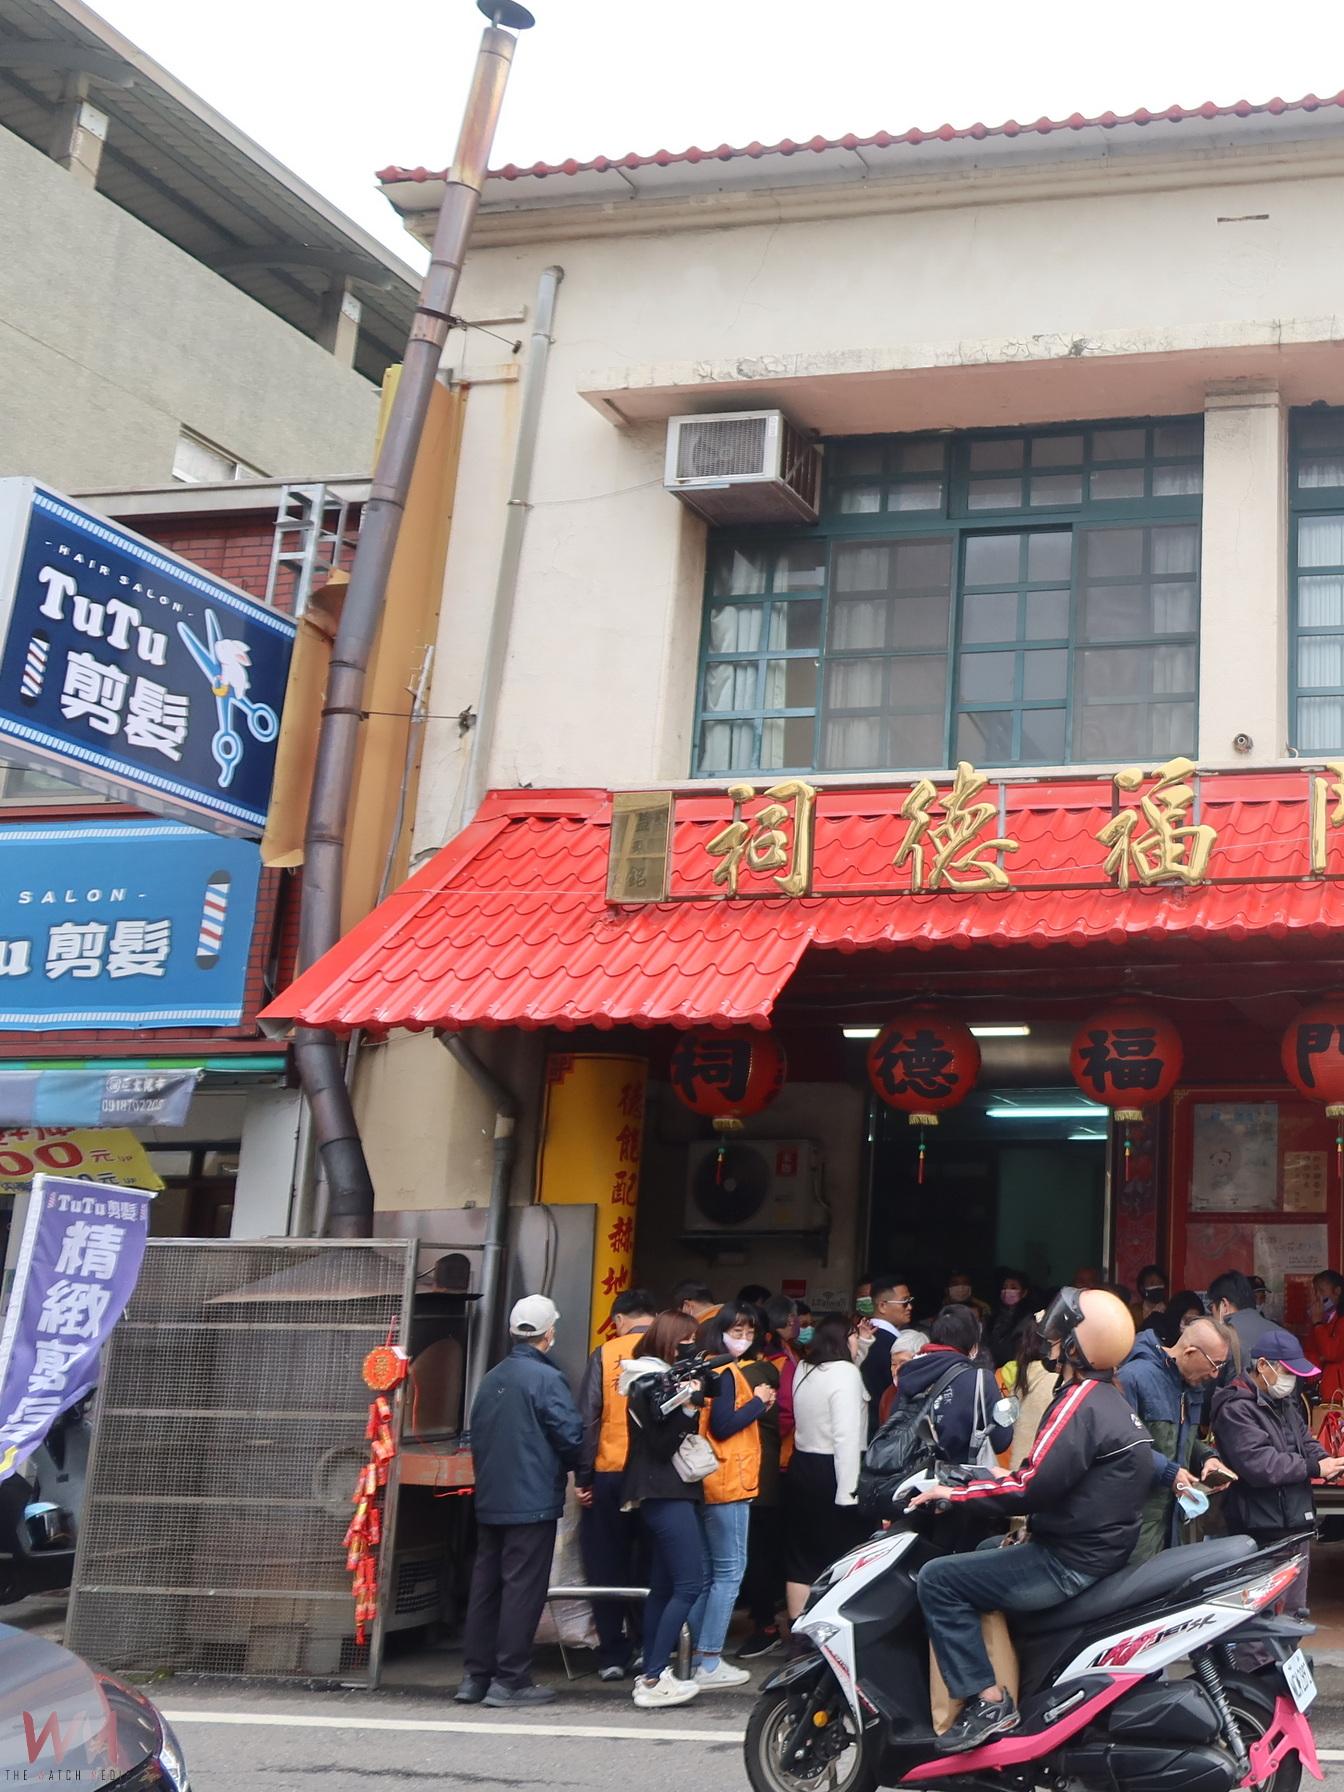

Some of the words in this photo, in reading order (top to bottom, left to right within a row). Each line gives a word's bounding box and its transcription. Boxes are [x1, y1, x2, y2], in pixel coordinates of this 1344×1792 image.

[58, 544, 111, 577] HAIR
[119, 575, 184, 613] SALON
[38, 565, 168, 666] TuTu
[61, 650, 190, 762] 剪髮
[18, 888, 127, 904] SALON
[45, 919, 171, 979] 剪髮
[671, 1032, 751, 1102] 祠
[874, 1027, 958, 1098] 德
[1078, 1026, 1164, 1094] 福
